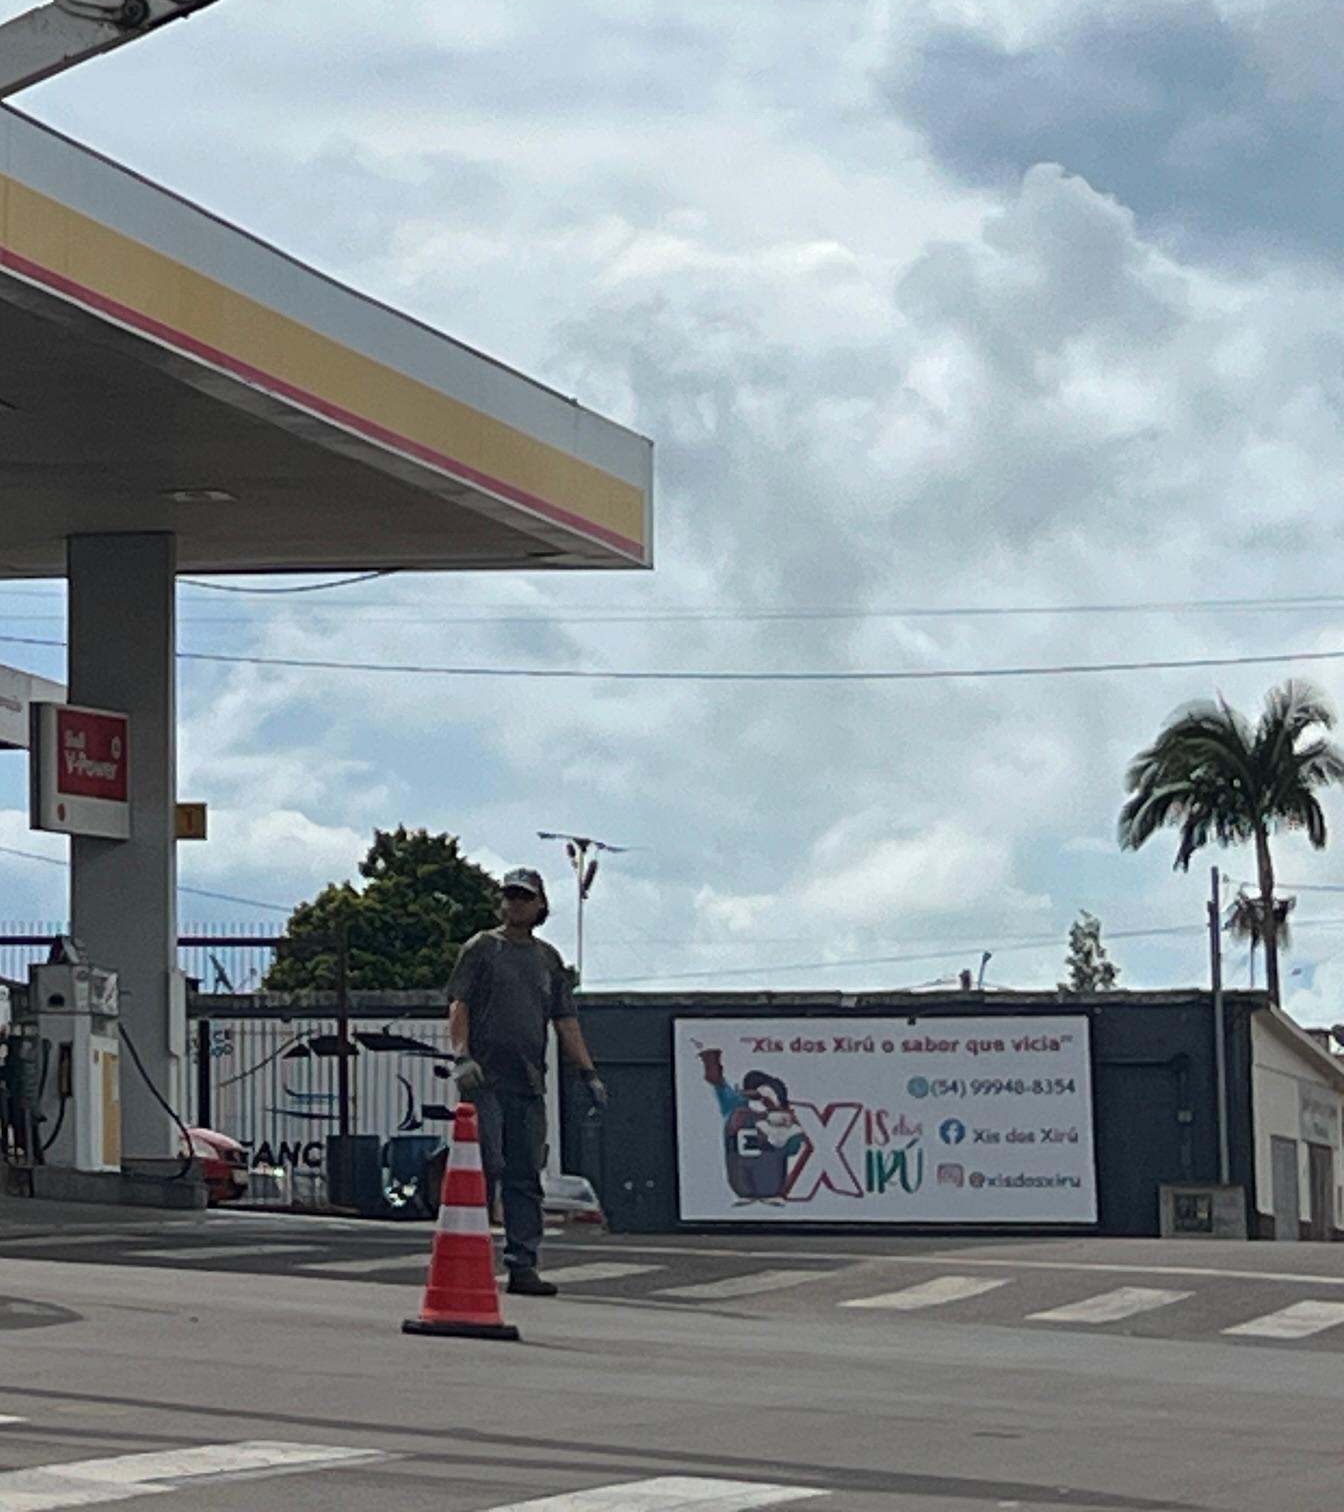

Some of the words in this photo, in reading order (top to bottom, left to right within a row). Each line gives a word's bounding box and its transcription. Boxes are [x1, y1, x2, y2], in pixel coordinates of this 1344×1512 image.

[789, 1037, 826, 1053] dos
[832, 1036, 874, 1054] Xirú
[881, 1039, 895, 1054] o
[901, 1036, 960, 1054] sabor
[965, 1039, 1005, 1056] que
[931, 1078, 967, 1099] (54)
[972, 1128, 1000, 1144] Xis
[1005, 1128, 1036, 1144] dos
[1040, 1126, 1079, 1144] Xirú
